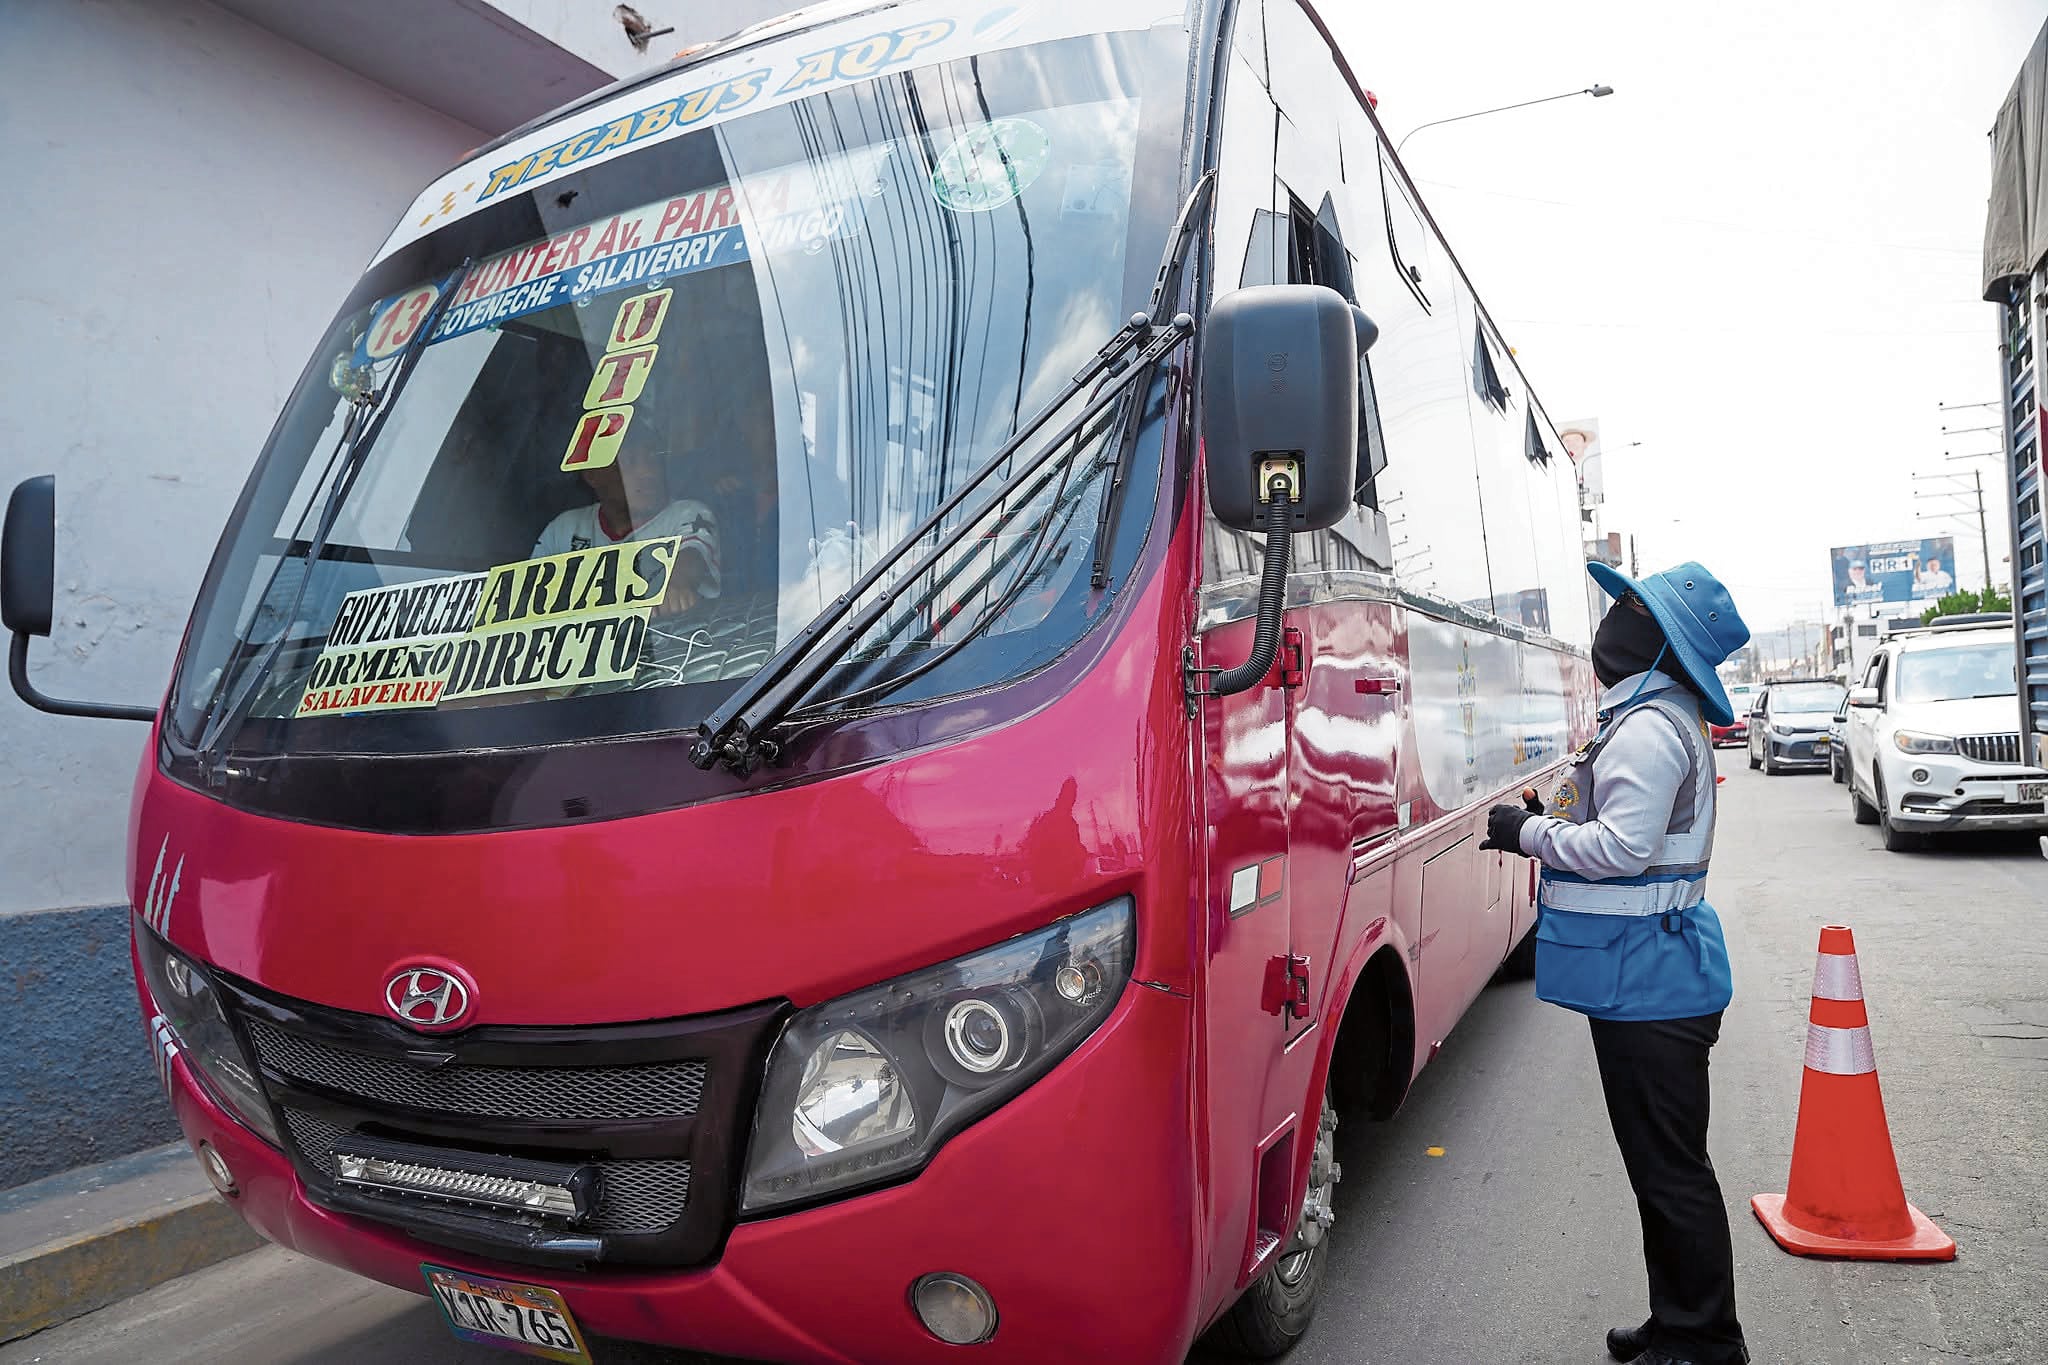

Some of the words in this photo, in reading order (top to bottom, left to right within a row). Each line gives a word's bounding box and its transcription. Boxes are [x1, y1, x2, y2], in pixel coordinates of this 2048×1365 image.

[476, 68, 772, 202] MEGABUS
[773, 17, 957, 97] AQP
[432, 274, 561, 341] GOYENECHE
[571, 231, 729, 296] SALAVERRY
[450, 226, 592, 307] HUNTER
[374, 290, 431, 351] 13
[328, 576, 488, 648] GOYENECHE
[476, 539, 677, 628] ARIAS
[309, 640, 455, 690] ORMEÑO
[444, 614, 646, 697] DIRECTO
[299, 680, 445, 713] SALAVERRY
